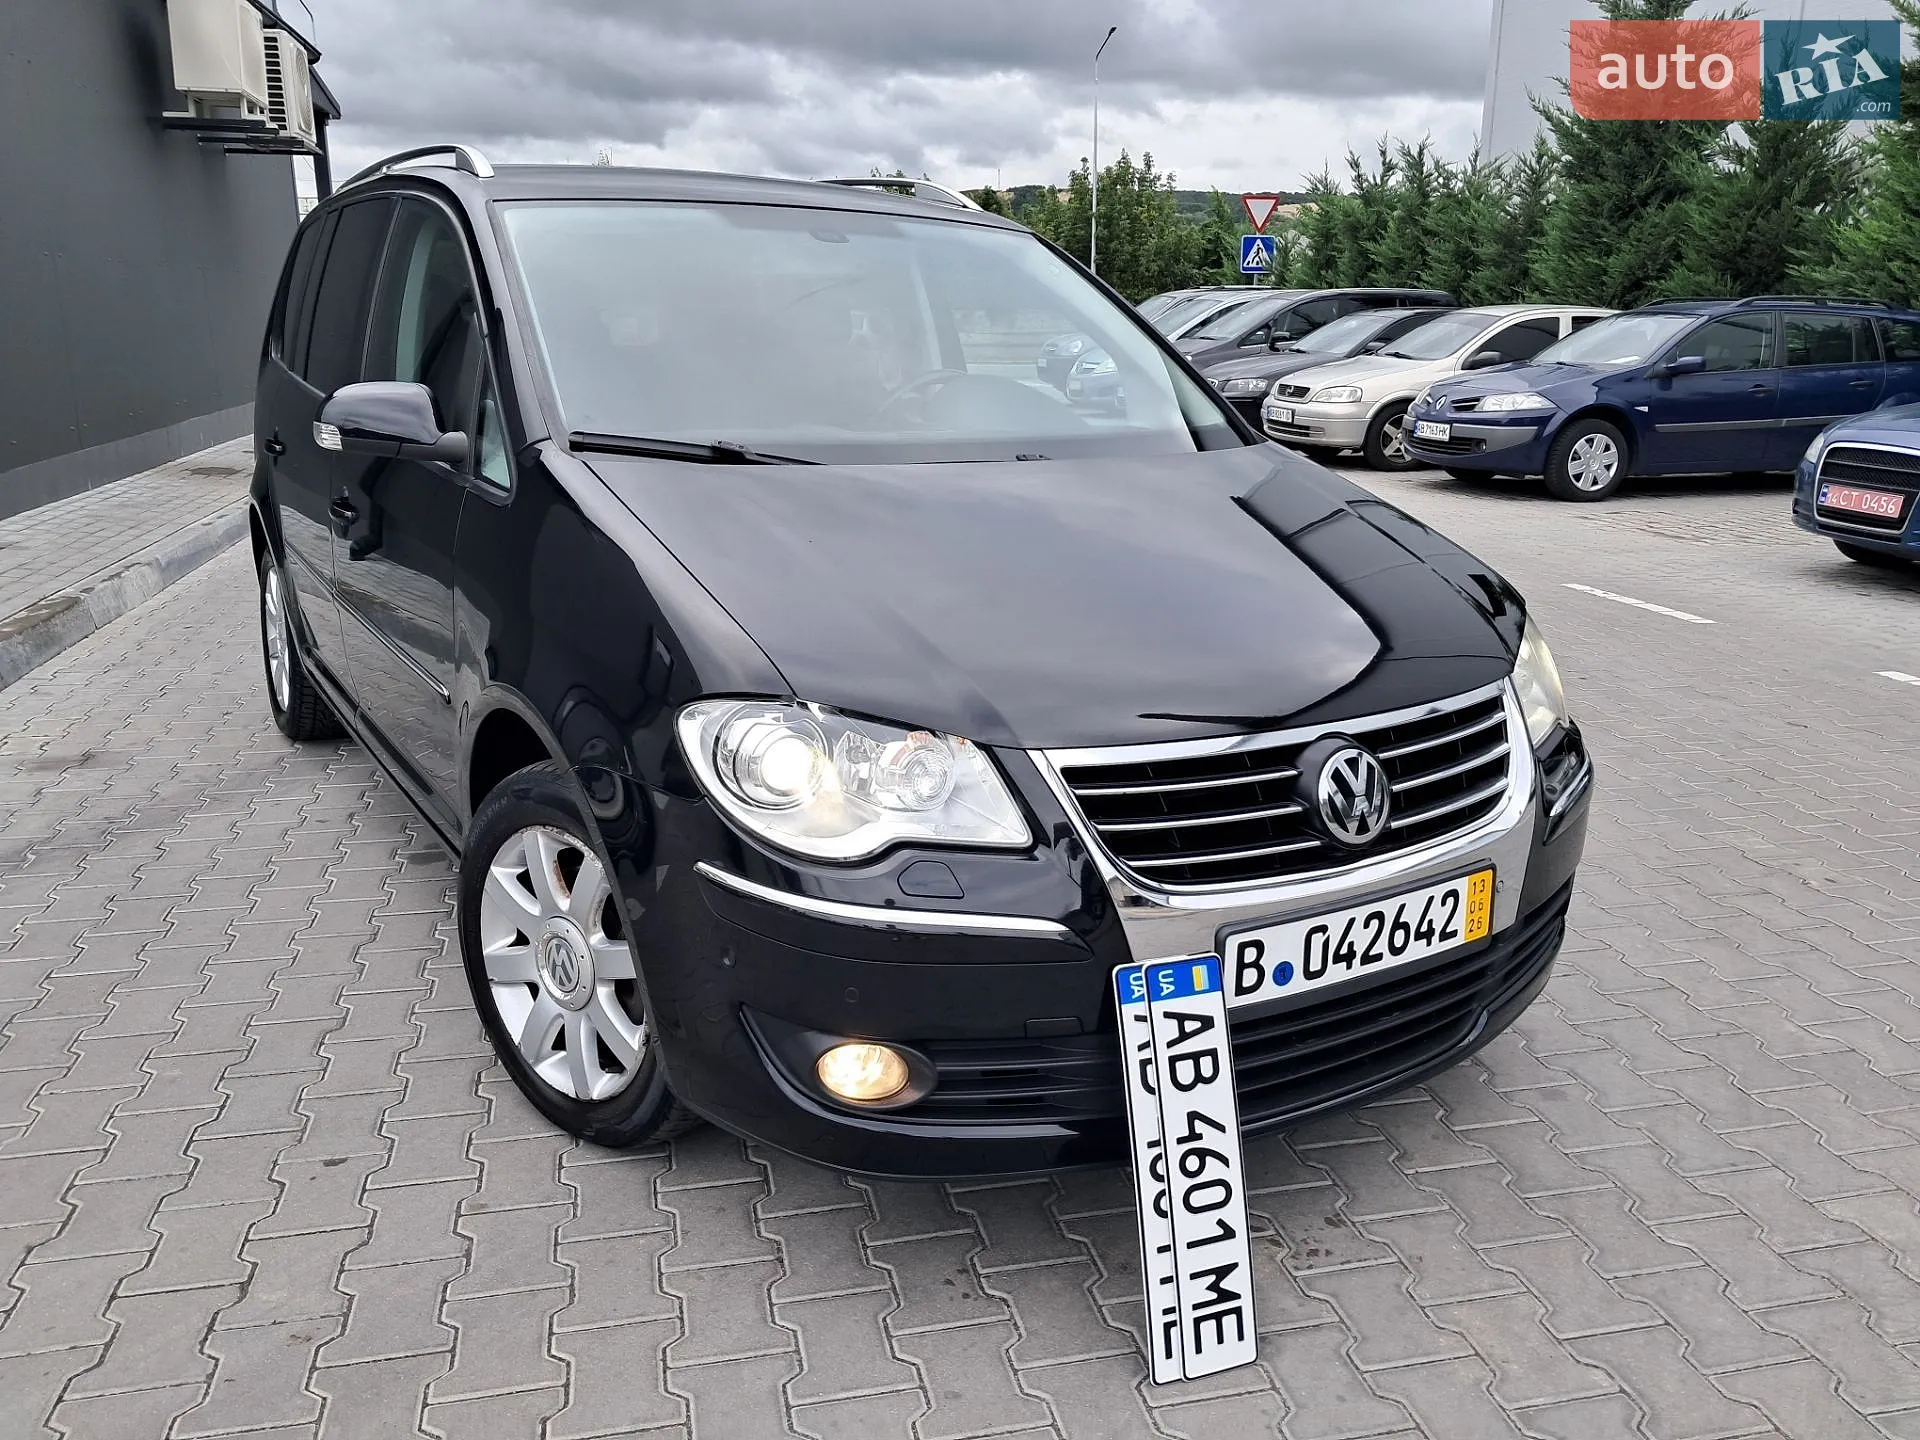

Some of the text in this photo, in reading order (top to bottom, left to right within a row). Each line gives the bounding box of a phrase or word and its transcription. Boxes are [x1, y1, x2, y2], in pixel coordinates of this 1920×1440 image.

[1862, 493, 1898, 513] 0456
[1472, 878, 1486, 896] 13
[1469, 898, 1484, 914] 06
[1468, 916, 1483, 933] 26
[1234, 888, 1461, 997] B 042642
[1158, 969, 1176, 997] UA
[1162, 1010, 1245, 1356] AB 4601 ME
